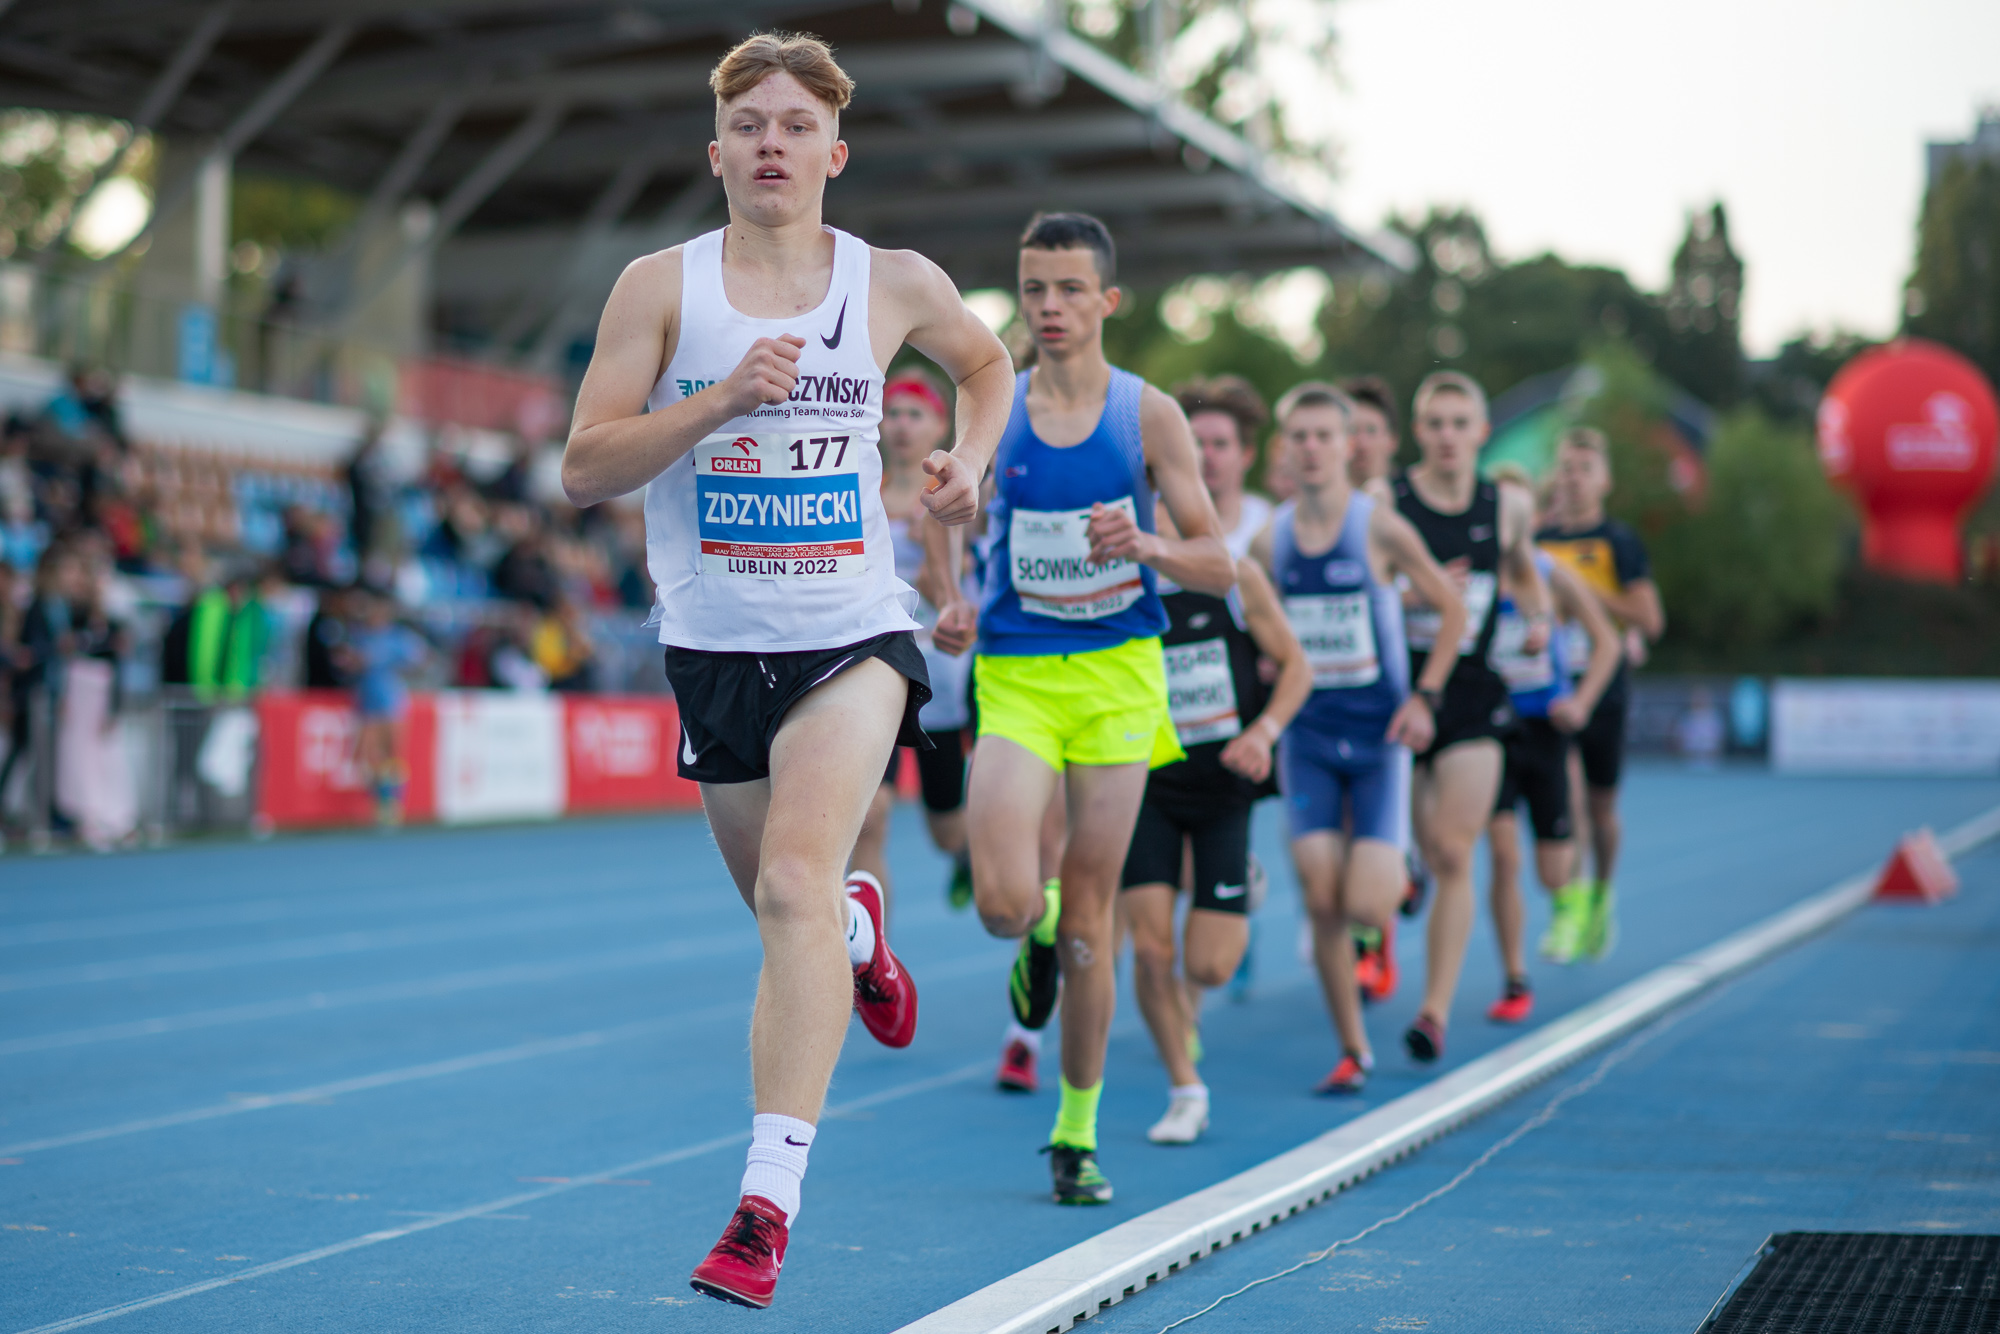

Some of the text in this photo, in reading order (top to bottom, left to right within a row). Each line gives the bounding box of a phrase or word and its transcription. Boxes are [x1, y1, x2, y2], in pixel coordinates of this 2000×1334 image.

[787, 372, 870, 405] CZYŃSKI
[792, 406, 819, 417] Team
[822, 407, 848, 418] Nowa
[849, 409, 865, 418] Sól
[789, 435, 850, 471] 177
[714, 458, 759, 473] ORLEN
[704, 490, 858, 527] ZDZYNIECKI
[730, 544, 747, 552] PZLA
[747, 545, 796, 553] MISTRZOSTWA
[728, 558, 838, 575] LUBLIN 2022
[1092, 595, 1123, 613] 2022
